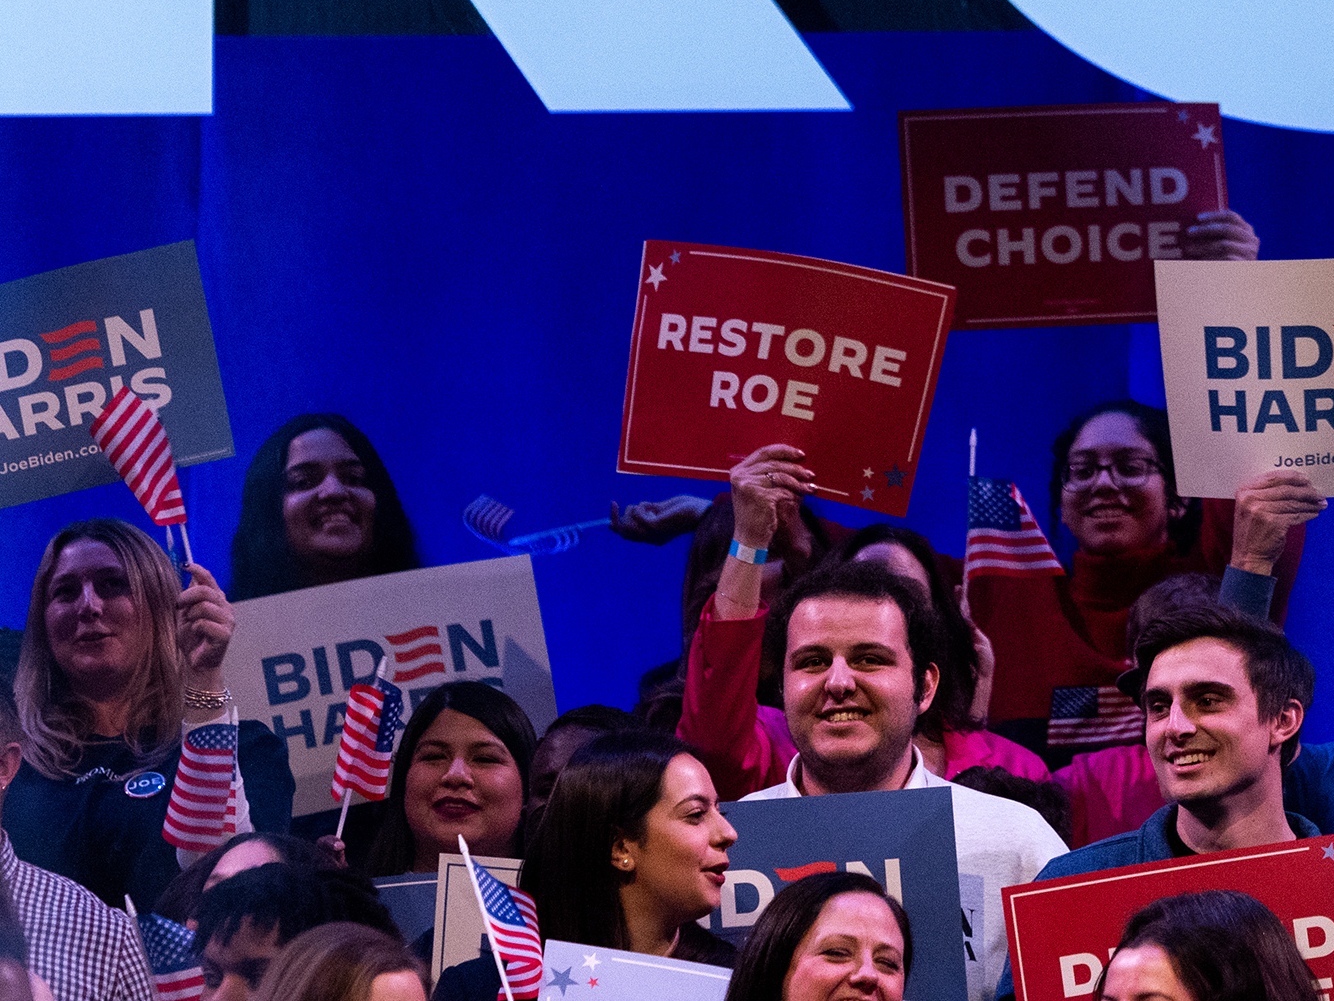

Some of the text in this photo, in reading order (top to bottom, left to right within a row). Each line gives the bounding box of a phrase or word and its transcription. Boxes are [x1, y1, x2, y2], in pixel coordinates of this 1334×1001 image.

[943, 166, 1189, 213] DEFEND
[955, 221, 1183, 268] CHOICE
[0, 307, 163, 392] DEN
[656, 312, 907, 388] RESTORE
[709, 370, 820, 421] ROE
[0, 442, 103, 475] JoeBiden.co
[261, 618, 500, 706] BIDEN
[128, 776, 161, 791] JOE
